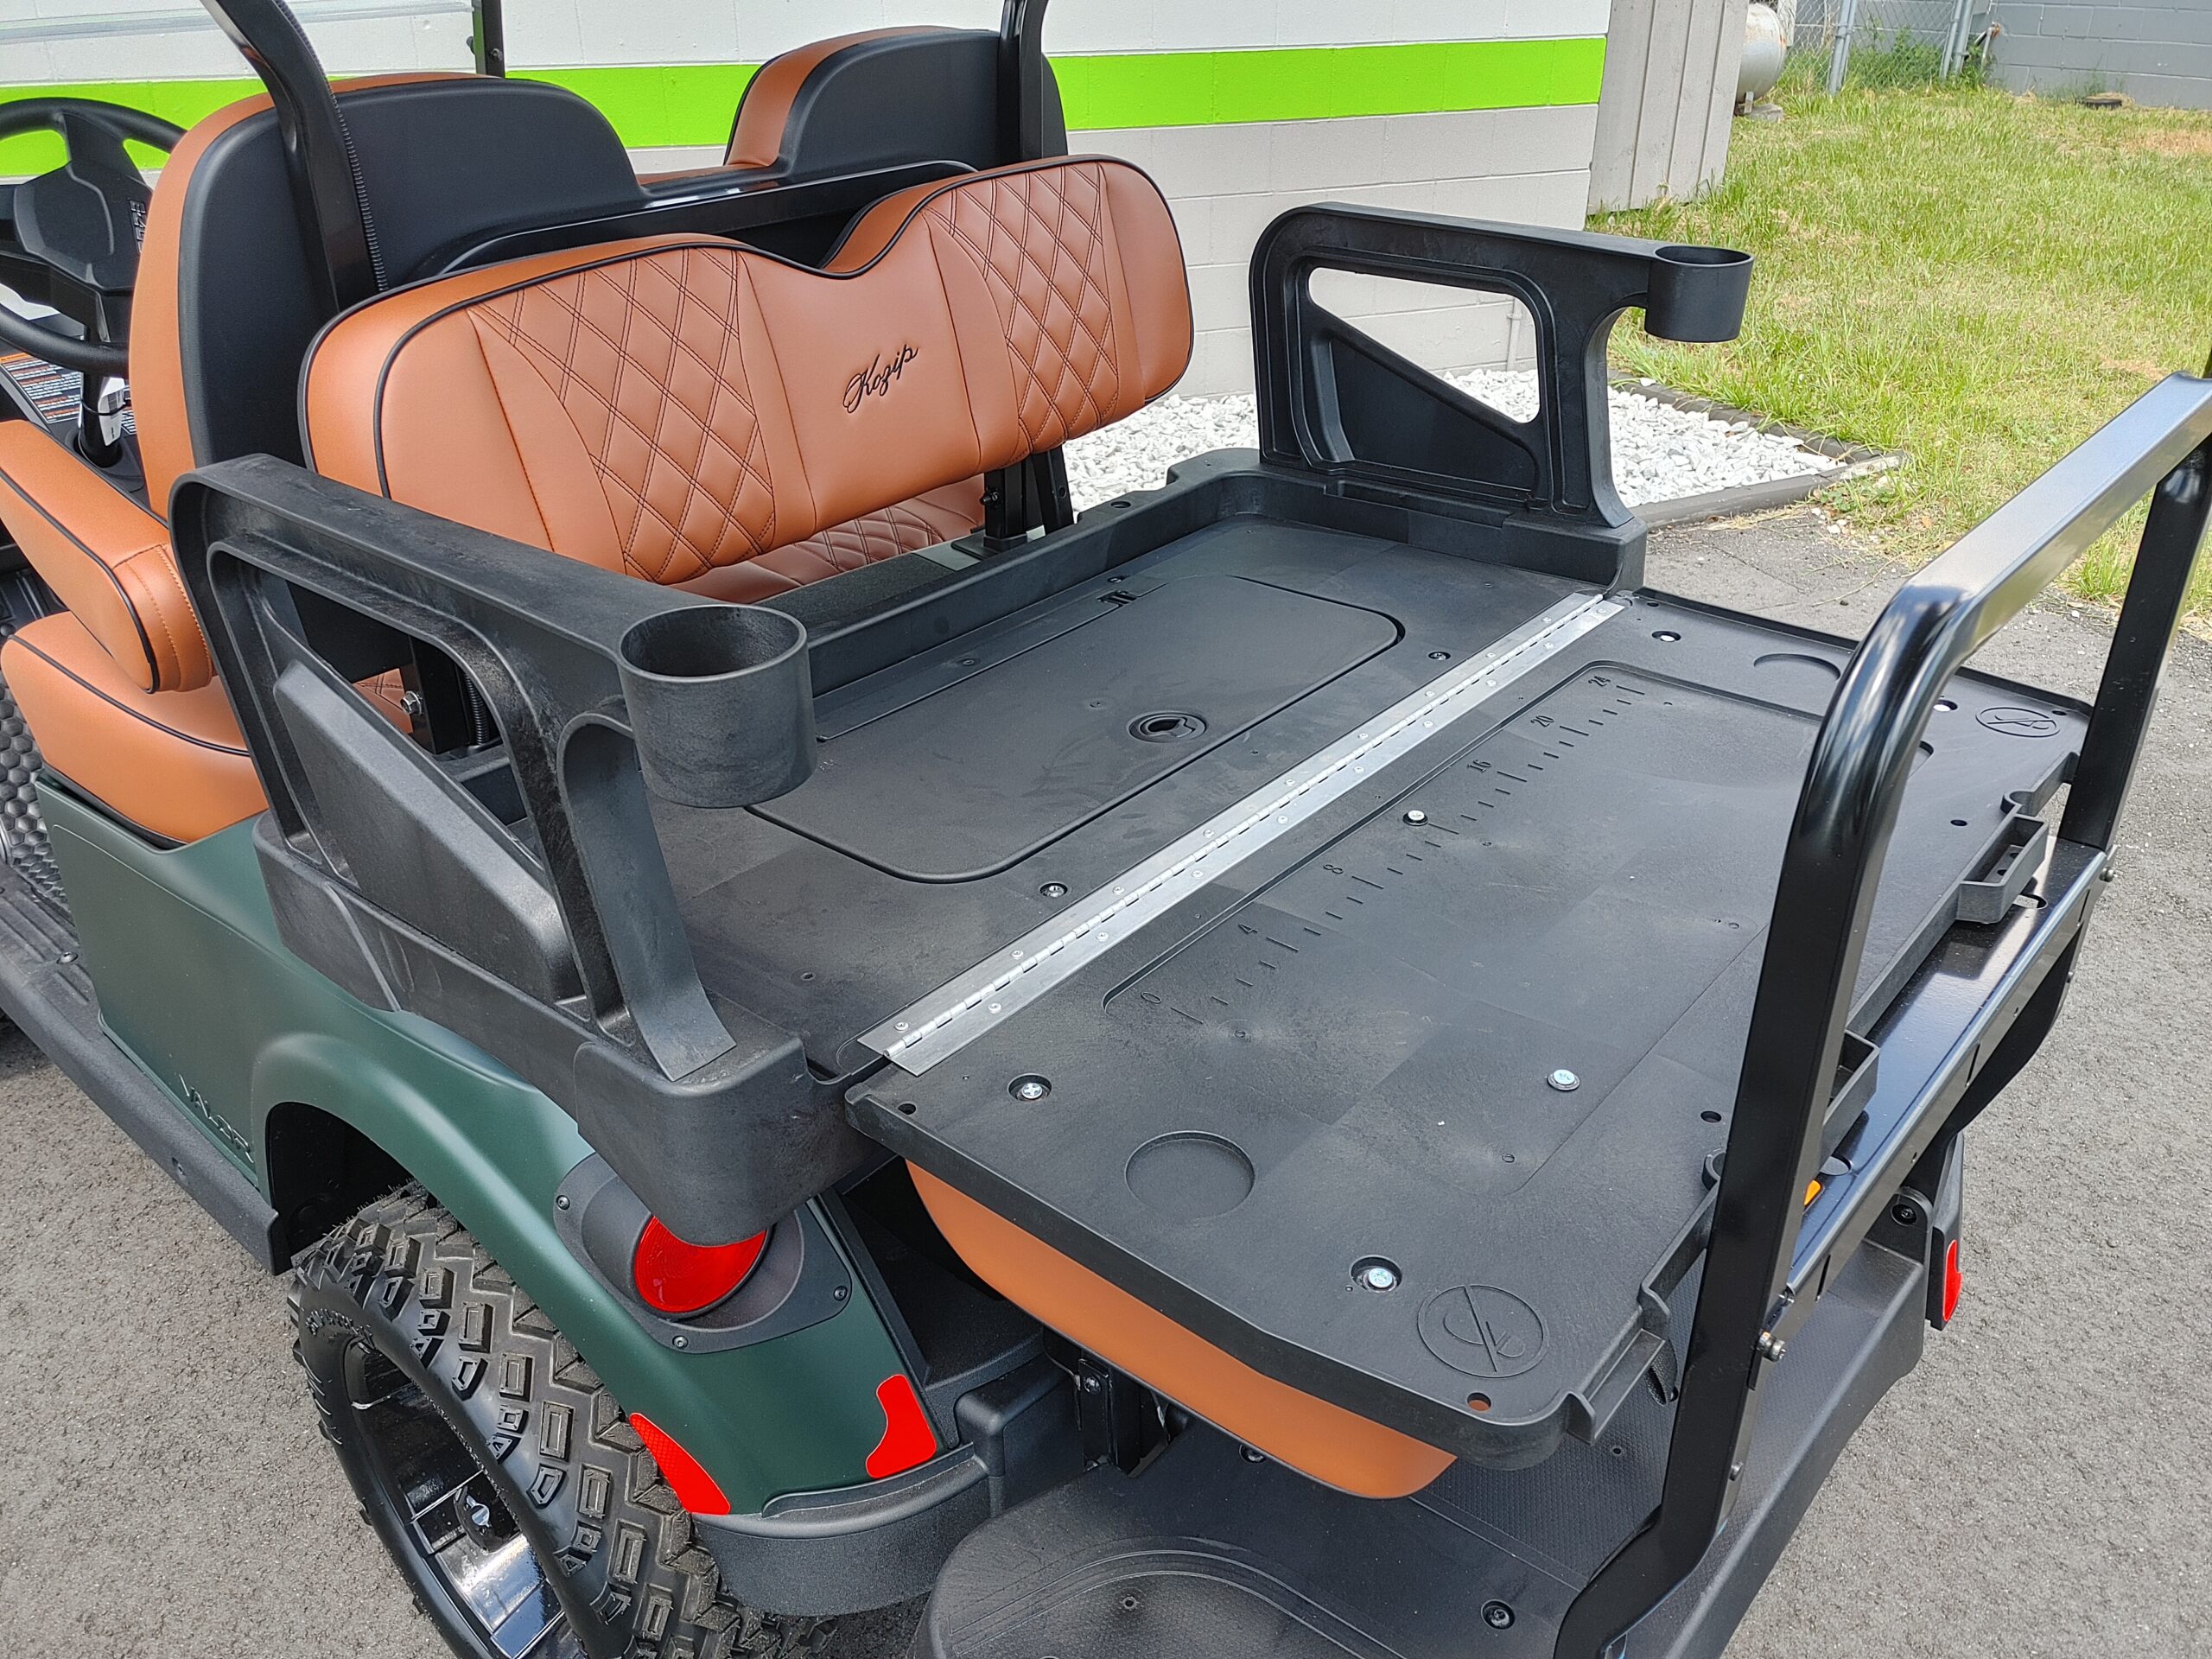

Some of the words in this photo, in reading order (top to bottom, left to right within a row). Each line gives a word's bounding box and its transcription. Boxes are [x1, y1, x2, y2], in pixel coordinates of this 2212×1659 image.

[1587, 675, 1611, 688] 24
[1529, 714, 1555, 728] 20
[1466, 759, 1492, 773] 16
[1323, 864, 1344, 875] 8
[1237, 922, 1259, 935] 4
